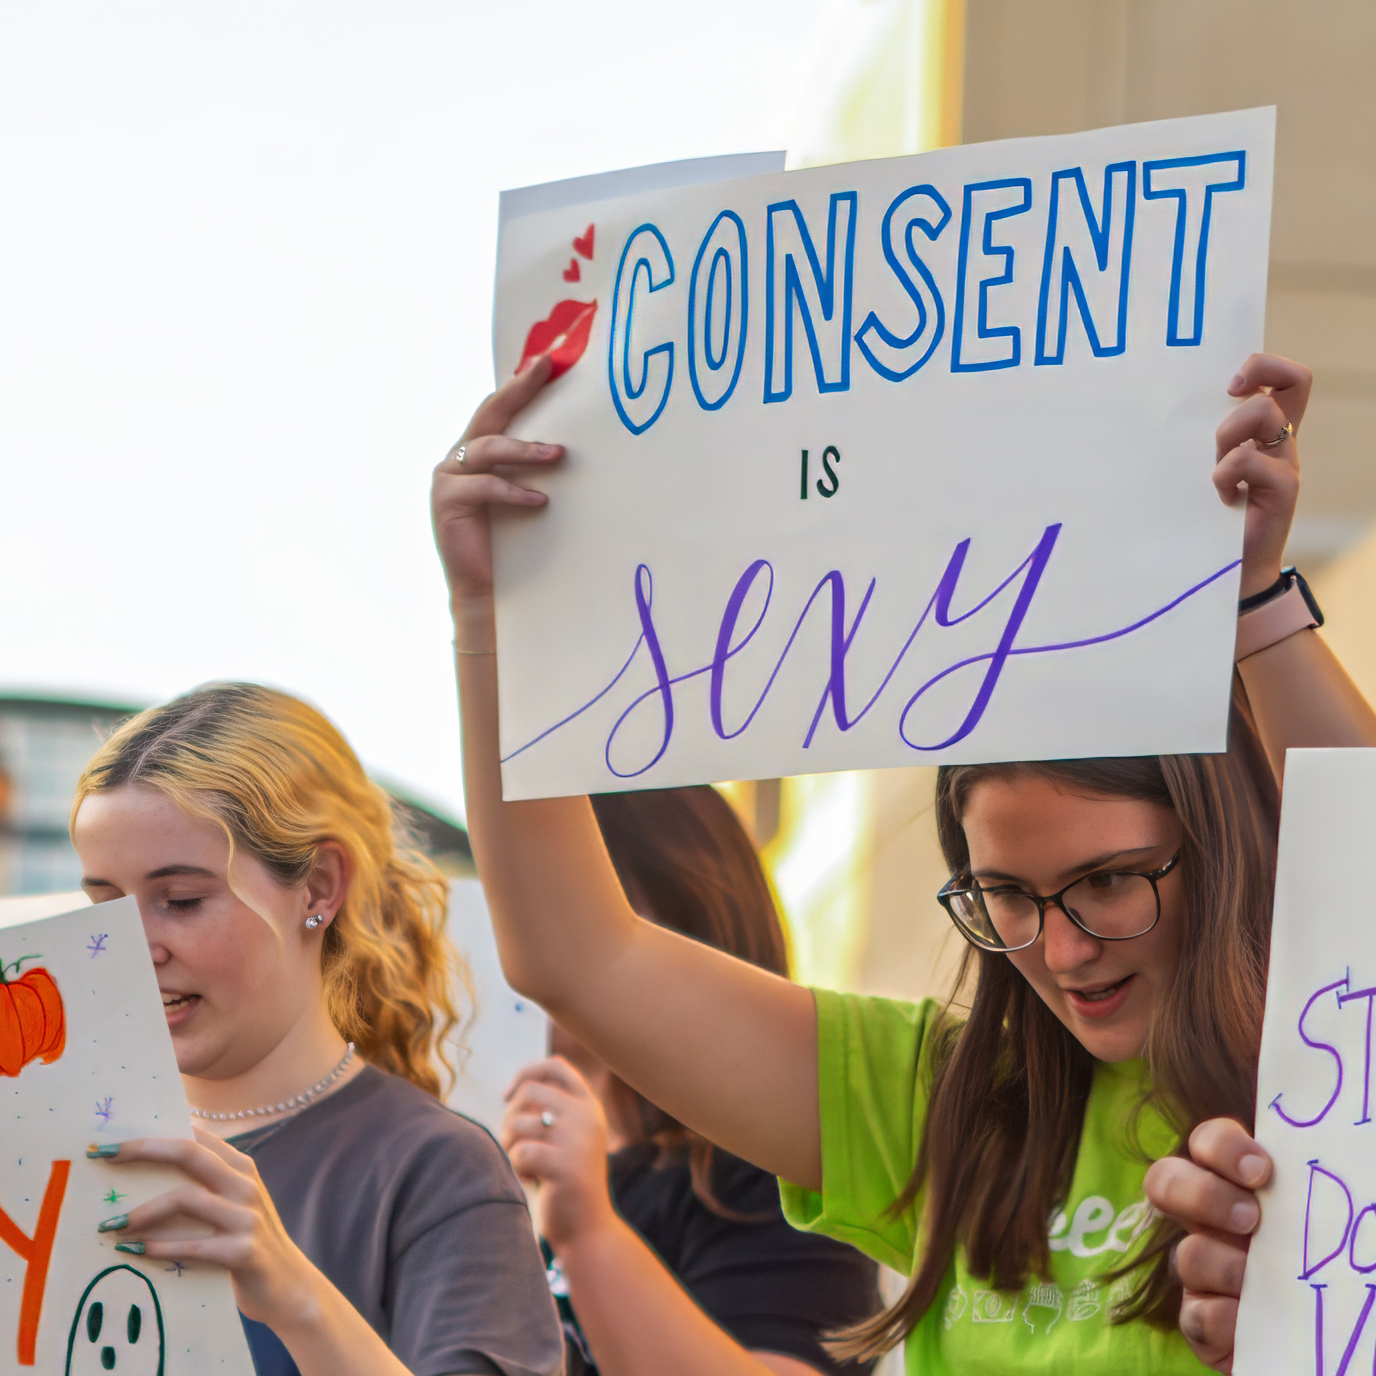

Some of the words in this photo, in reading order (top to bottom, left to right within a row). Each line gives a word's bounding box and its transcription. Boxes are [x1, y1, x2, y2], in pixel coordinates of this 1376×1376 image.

[608, 150, 1246, 436] CONSENT
[801, 446, 841, 499] IS
[502, 522, 1242, 778] sexy
